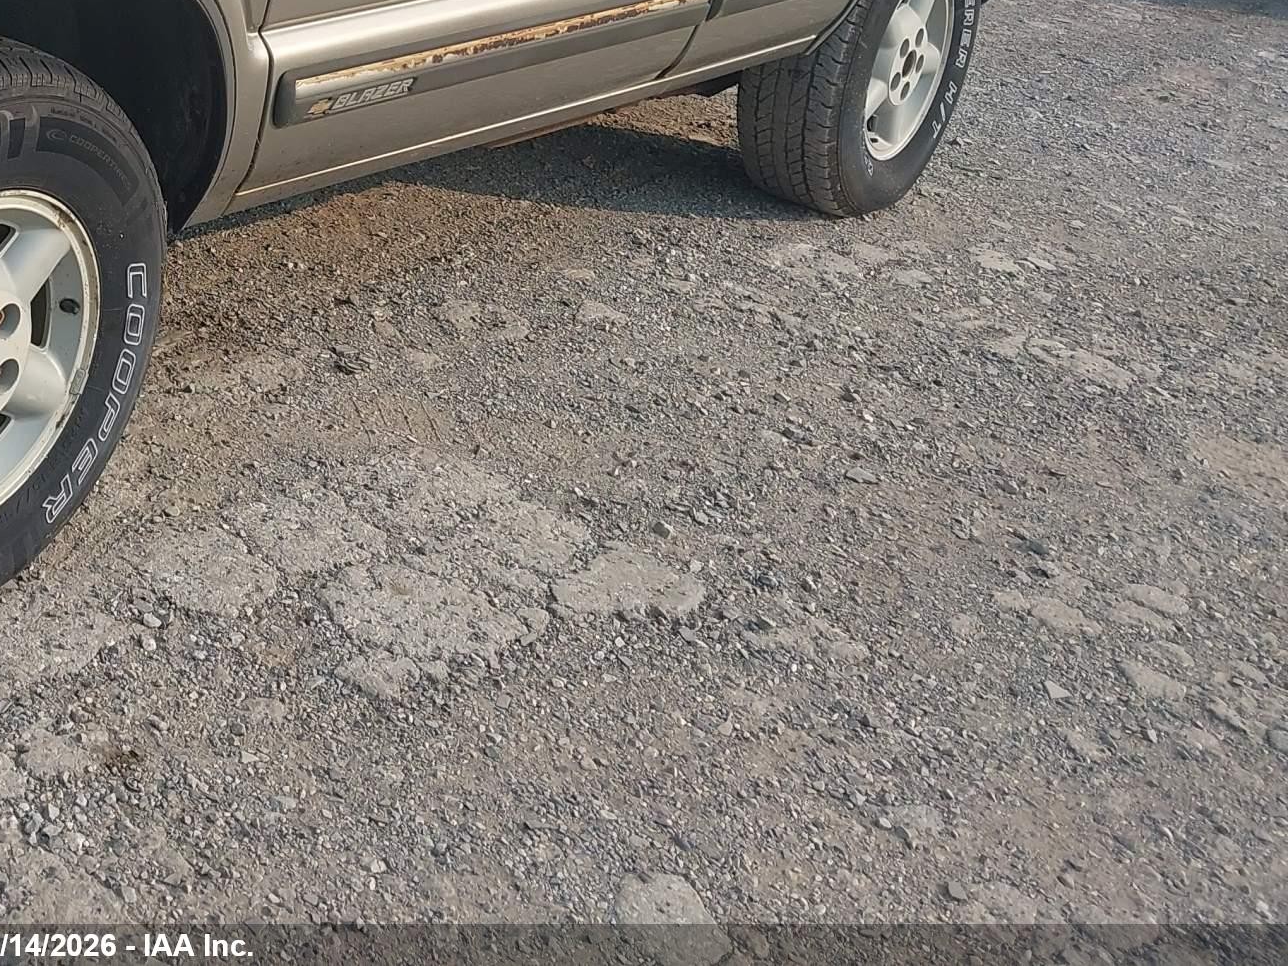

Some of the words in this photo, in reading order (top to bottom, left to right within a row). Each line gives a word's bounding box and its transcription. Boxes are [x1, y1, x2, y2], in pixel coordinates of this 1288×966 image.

[332, 78, 414, 110] BLAZER
[931, 80, 958, 139] H/T
[42, 263, 148, 524] COOPER
